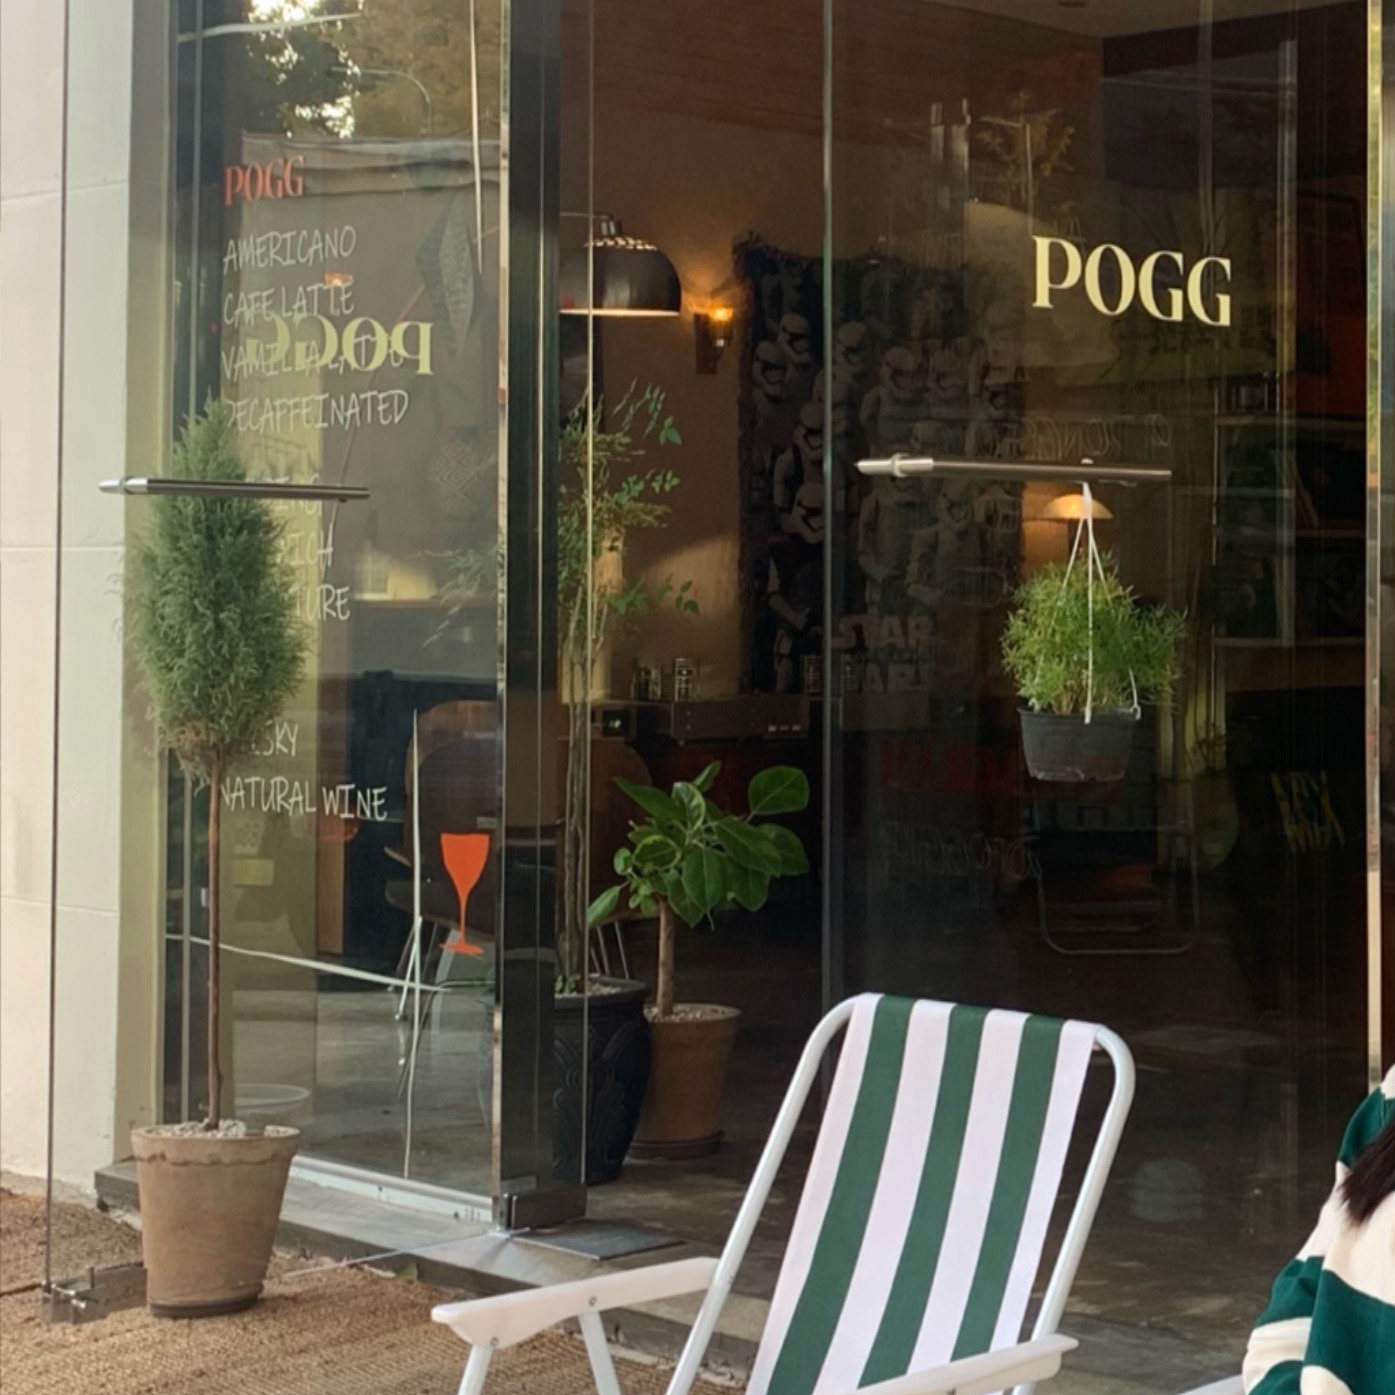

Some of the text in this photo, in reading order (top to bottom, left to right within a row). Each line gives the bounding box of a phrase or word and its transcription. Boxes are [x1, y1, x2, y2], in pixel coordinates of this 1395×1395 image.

[224, 155, 304, 207] POGG
[222, 225, 357, 276] AMERICANO
[223, 281, 355, 328] CAFE LATTE
[1032, 235, 1231, 327] POGG
[221, 341, 321, 382] VANILA
[225, 389, 409, 434] DECAFFEINATED
[322, 783, 388, 821] WINE
